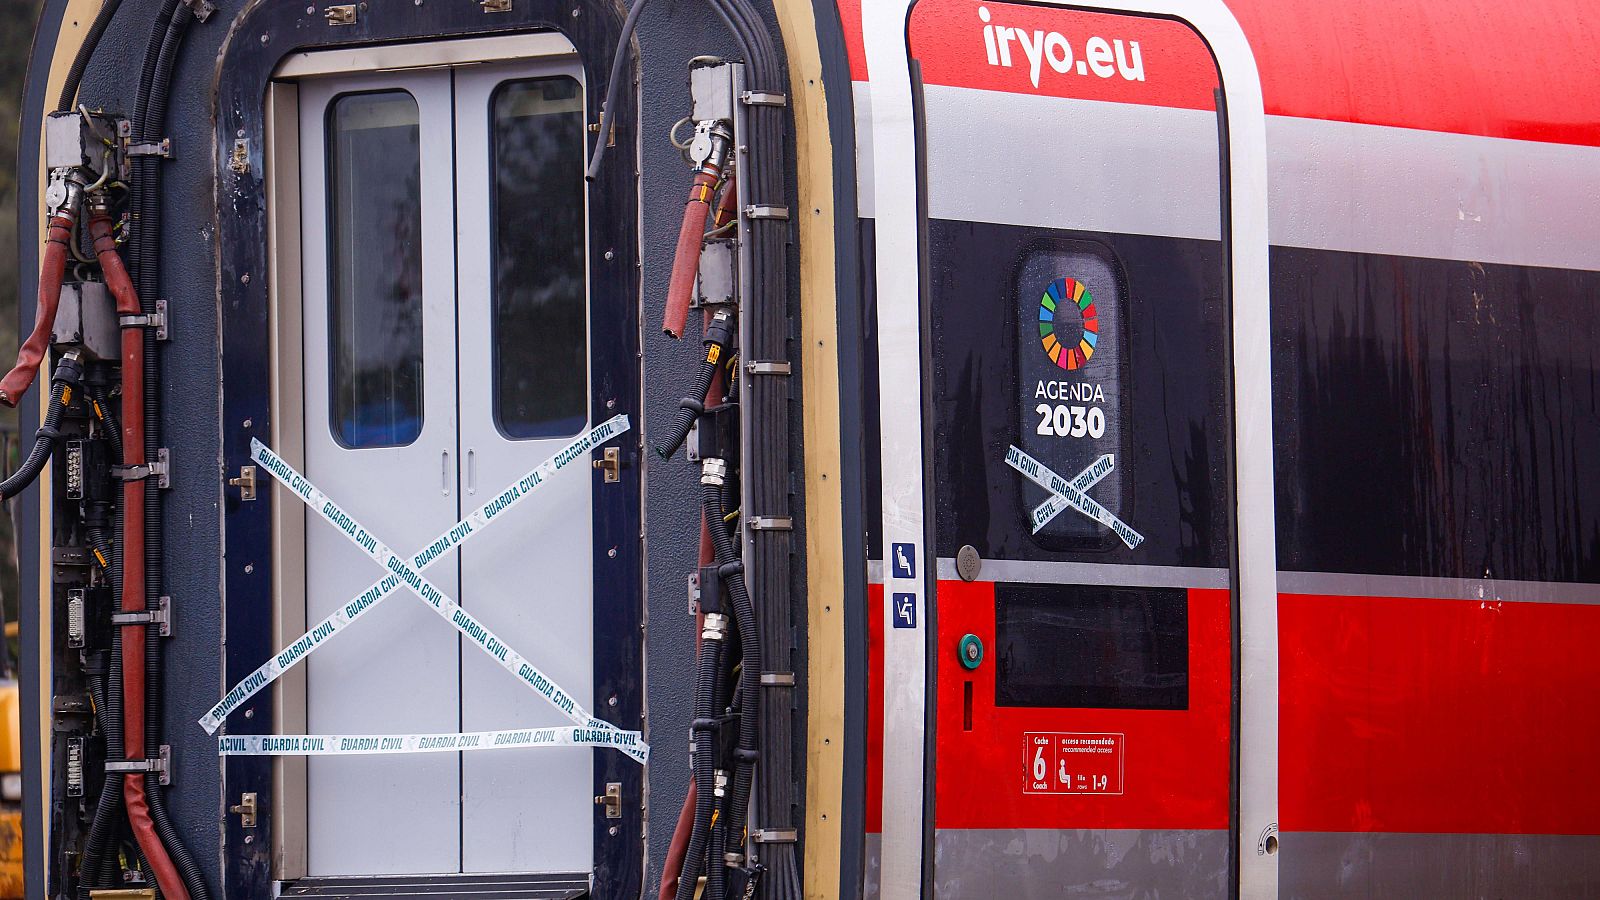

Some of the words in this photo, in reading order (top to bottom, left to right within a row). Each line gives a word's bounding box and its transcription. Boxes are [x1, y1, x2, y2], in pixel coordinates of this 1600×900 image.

[978, 6, 1145, 89] iryo.eu
[1035, 380, 1105, 402] AGENDA
[1036, 403, 1106, 439] 2030
[1020, 456, 1039, 478] CIVIL
[1050, 476, 1082, 505] GUARDIA
[1082, 497, 1101, 519] CIVIL
[1036, 502, 1056, 523] CIVIL
[1093, 457, 1113, 477] CIVIL
[244, 670, 267, 693] CIVIL
[277, 636, 314, 668] GUARDIA
[312, 620, 335, 643] CIVIL
[345, 586, 382, 619] GUARDIA
[380, 573, 400, 593] CIVI
[414, 536, 451, 569] GUARDIA
[449, 520, 473, 544] CIVIL
[484, 487, 521, 519] GUARDIA
[519, 471, 543, 494] CIVIL
[554, 437, 592, 470] GUARDIA
[591, 423, 614, 444] CIVIL
[258, 448, 293, 483] GUARDIA
[291, 475, 313, 499] CIVIL
[322, 501, 357, 536] GUARDIA
[355, 529, 378, 554] CIVIL
[387, 555, 422, 591] GUARDIA
[420, 583, 442, 608] CIVIL
[452, 610, 488, 645] GUARDIA
[486, 637, 508, 662] CIVIL
[518, 663, 552, 698] GUARDIA
[553, 690, 575, 714] CIVIL
[262, 738, 299, 752] GUARDIA
[302, 737, 324, 751] CIVIL
[340, 737, 379, 751] GUARDIA
[380, 737, 403, 750] CIVIL
[418, 735, 456, 749] GUARDIA
[457, 735, 480, 748] CIVIL
[494, 732, 532, 745] GUARDIA
[533, 730, 556, 743] CIVIL
[573, 729, 611, 743] GUARDIA
[614, 732, 637, 746] CIVIL
[1033, 746, 1046, 781] 6
[1032, 781, 1048, 790] Coach
[1092, 774, 1108, 790] 1-9
